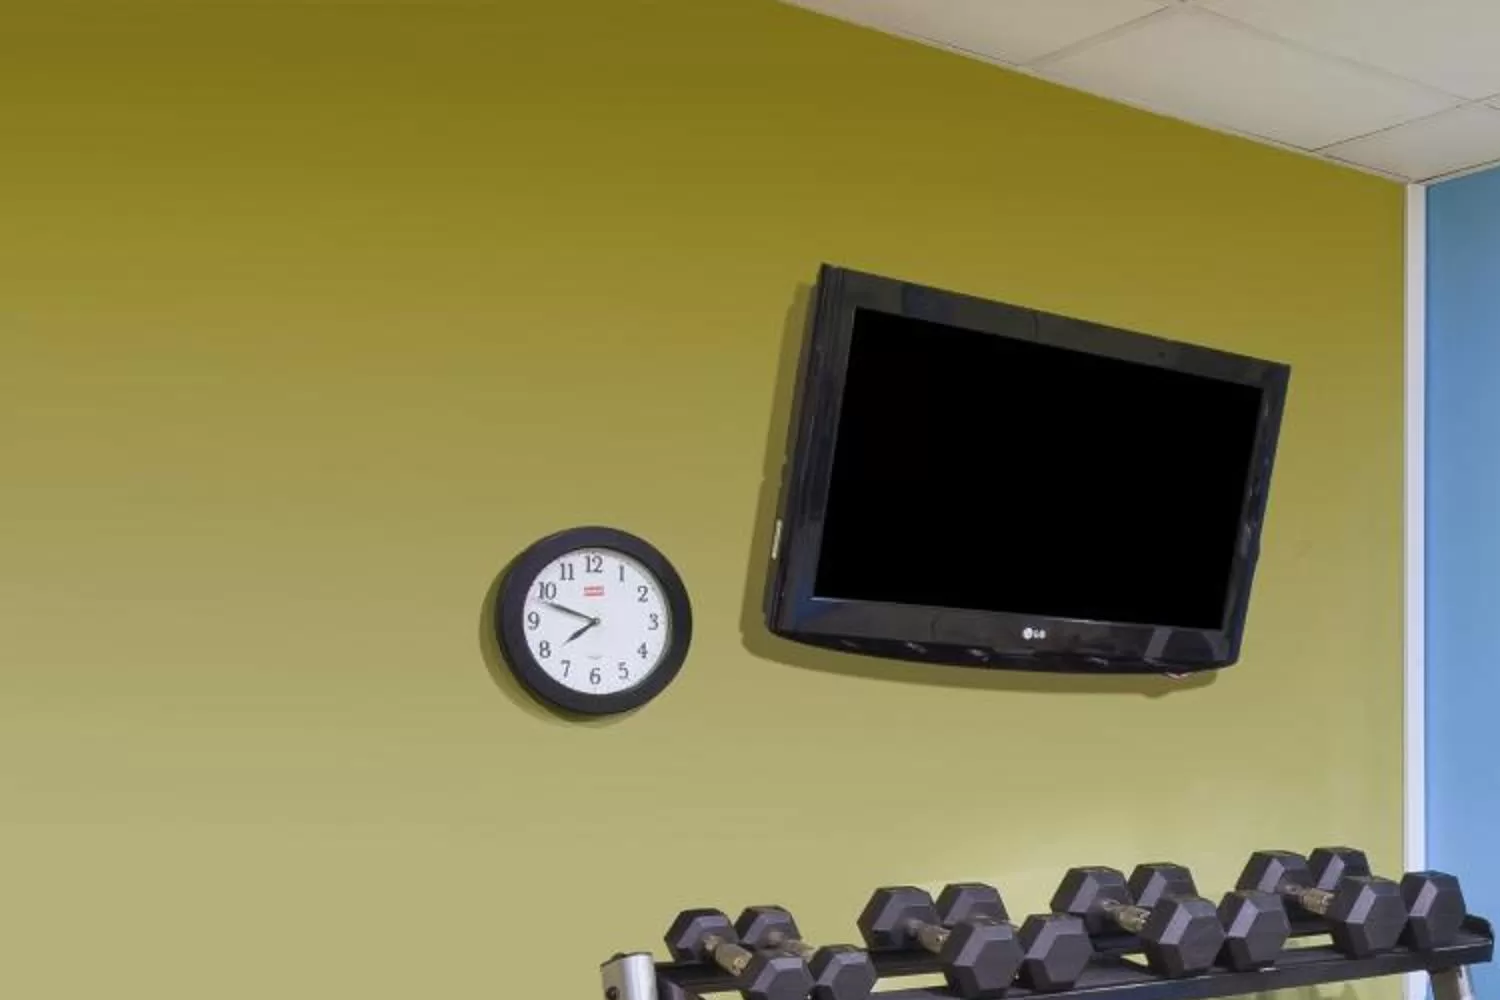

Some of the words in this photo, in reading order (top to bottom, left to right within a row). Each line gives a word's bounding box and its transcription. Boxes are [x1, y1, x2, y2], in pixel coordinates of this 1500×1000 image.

[560, 563, 575, 581] 11
[584, 555, 603, 573] 12
[619, 565, 625, 582] 1
[537, 581, 557, 601] 10
[637, 585, 649, 602] 2
[527, 611, 540, 630] 9
[648, 613, 659, 631] 3
[539, 640, 551, 659] 8
[637, 642, 648, 659] 4
[561, 660, 571, 678] 7
[589, 668, 601, 685] 6
[618, 662, 629, 679] 5
